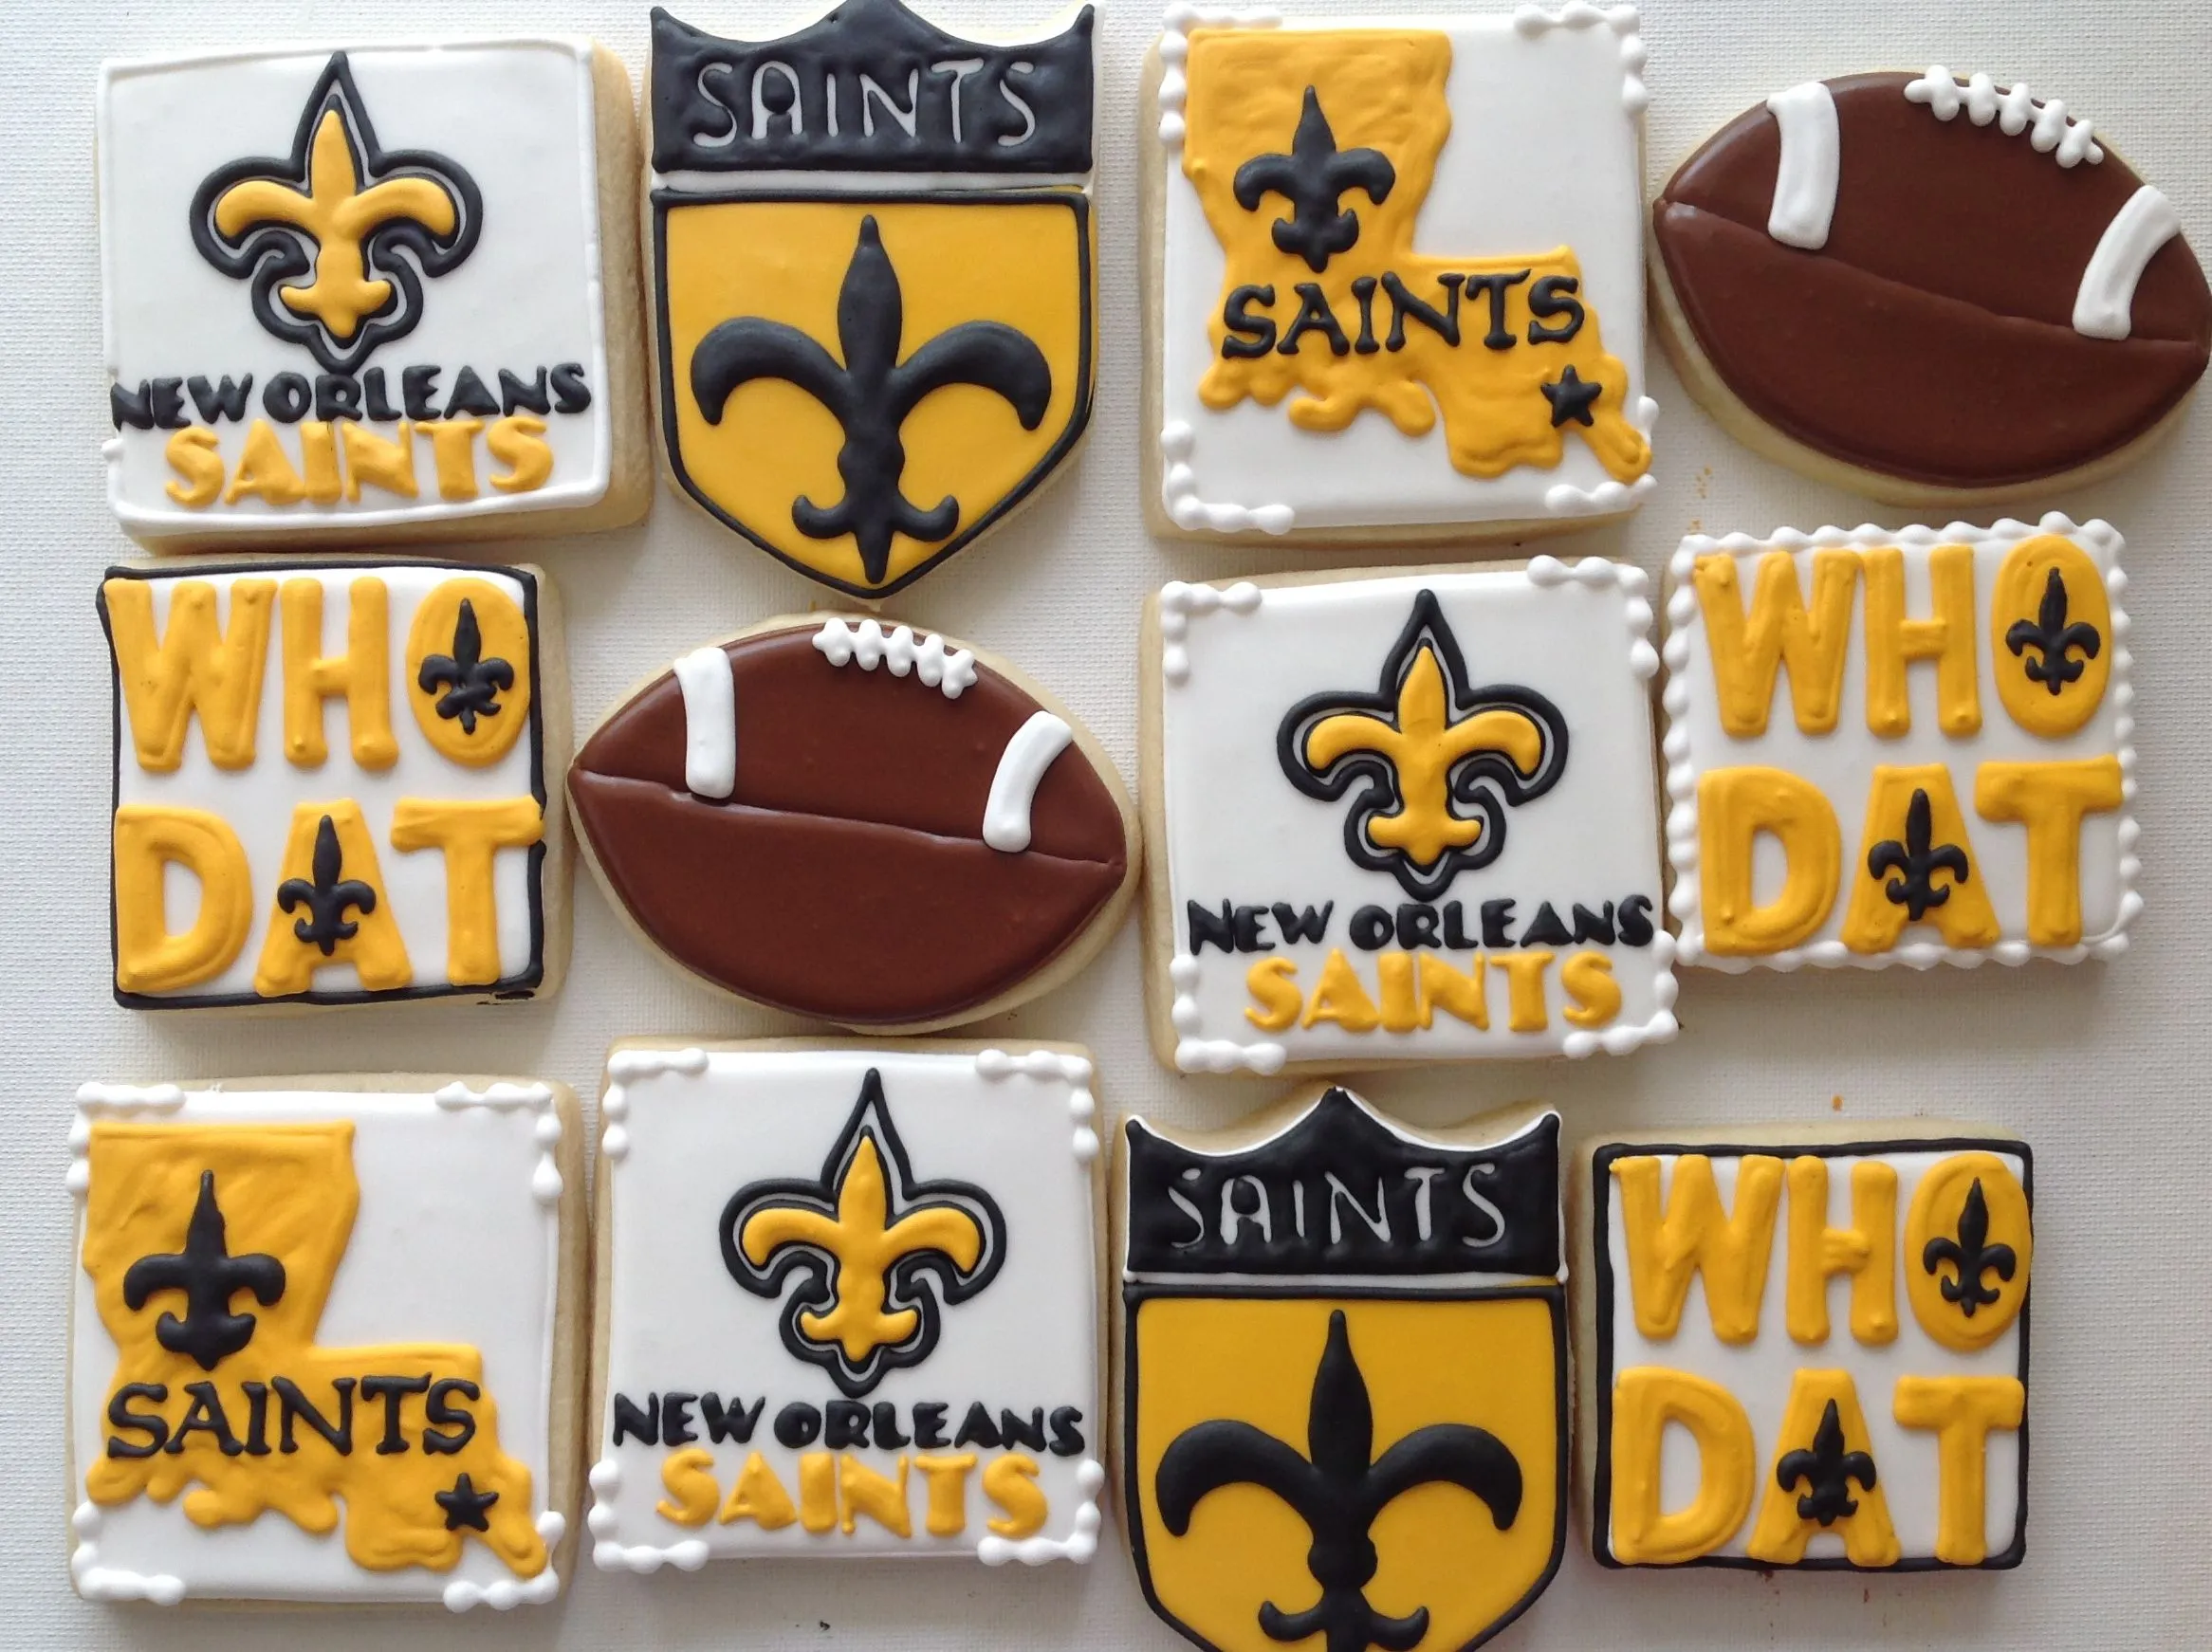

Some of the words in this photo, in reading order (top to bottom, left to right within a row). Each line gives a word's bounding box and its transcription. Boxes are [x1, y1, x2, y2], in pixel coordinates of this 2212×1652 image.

[693, 59, 1035, 147] SAINTS
[1222, 268, 1585, 358] SAINTS
[110, 373, 253, 431] NEW
[263, 362, 592, 424] ORLEANS
[165, 416, 554, 509] SAINTS
[103, 577, 531, 773] WHO
[1693, 534, 2112, 739] WHO
[115, 797, 544, 997] DAT
[1697, 754, 2124, 956] DAT
[1187, 898, 1334, 955] NEW
[1349, 894, 1653, 950] ORLEANS
[1244, 948, 1622, 1033] SAINTS
[1169, 1163, 1505, 1248] SAINTS
[1610, 1149, 2033, 1351] WHO
[106, 1372, 480, 1459] SAINTS
[613, 1391, 765, 1446] NEW
[773, 1400, 1085, 1456] ORLEANS
[655, 1448, 1048, 1540] SAINTS
[1613, 1366, 2025, 1567] DAT
